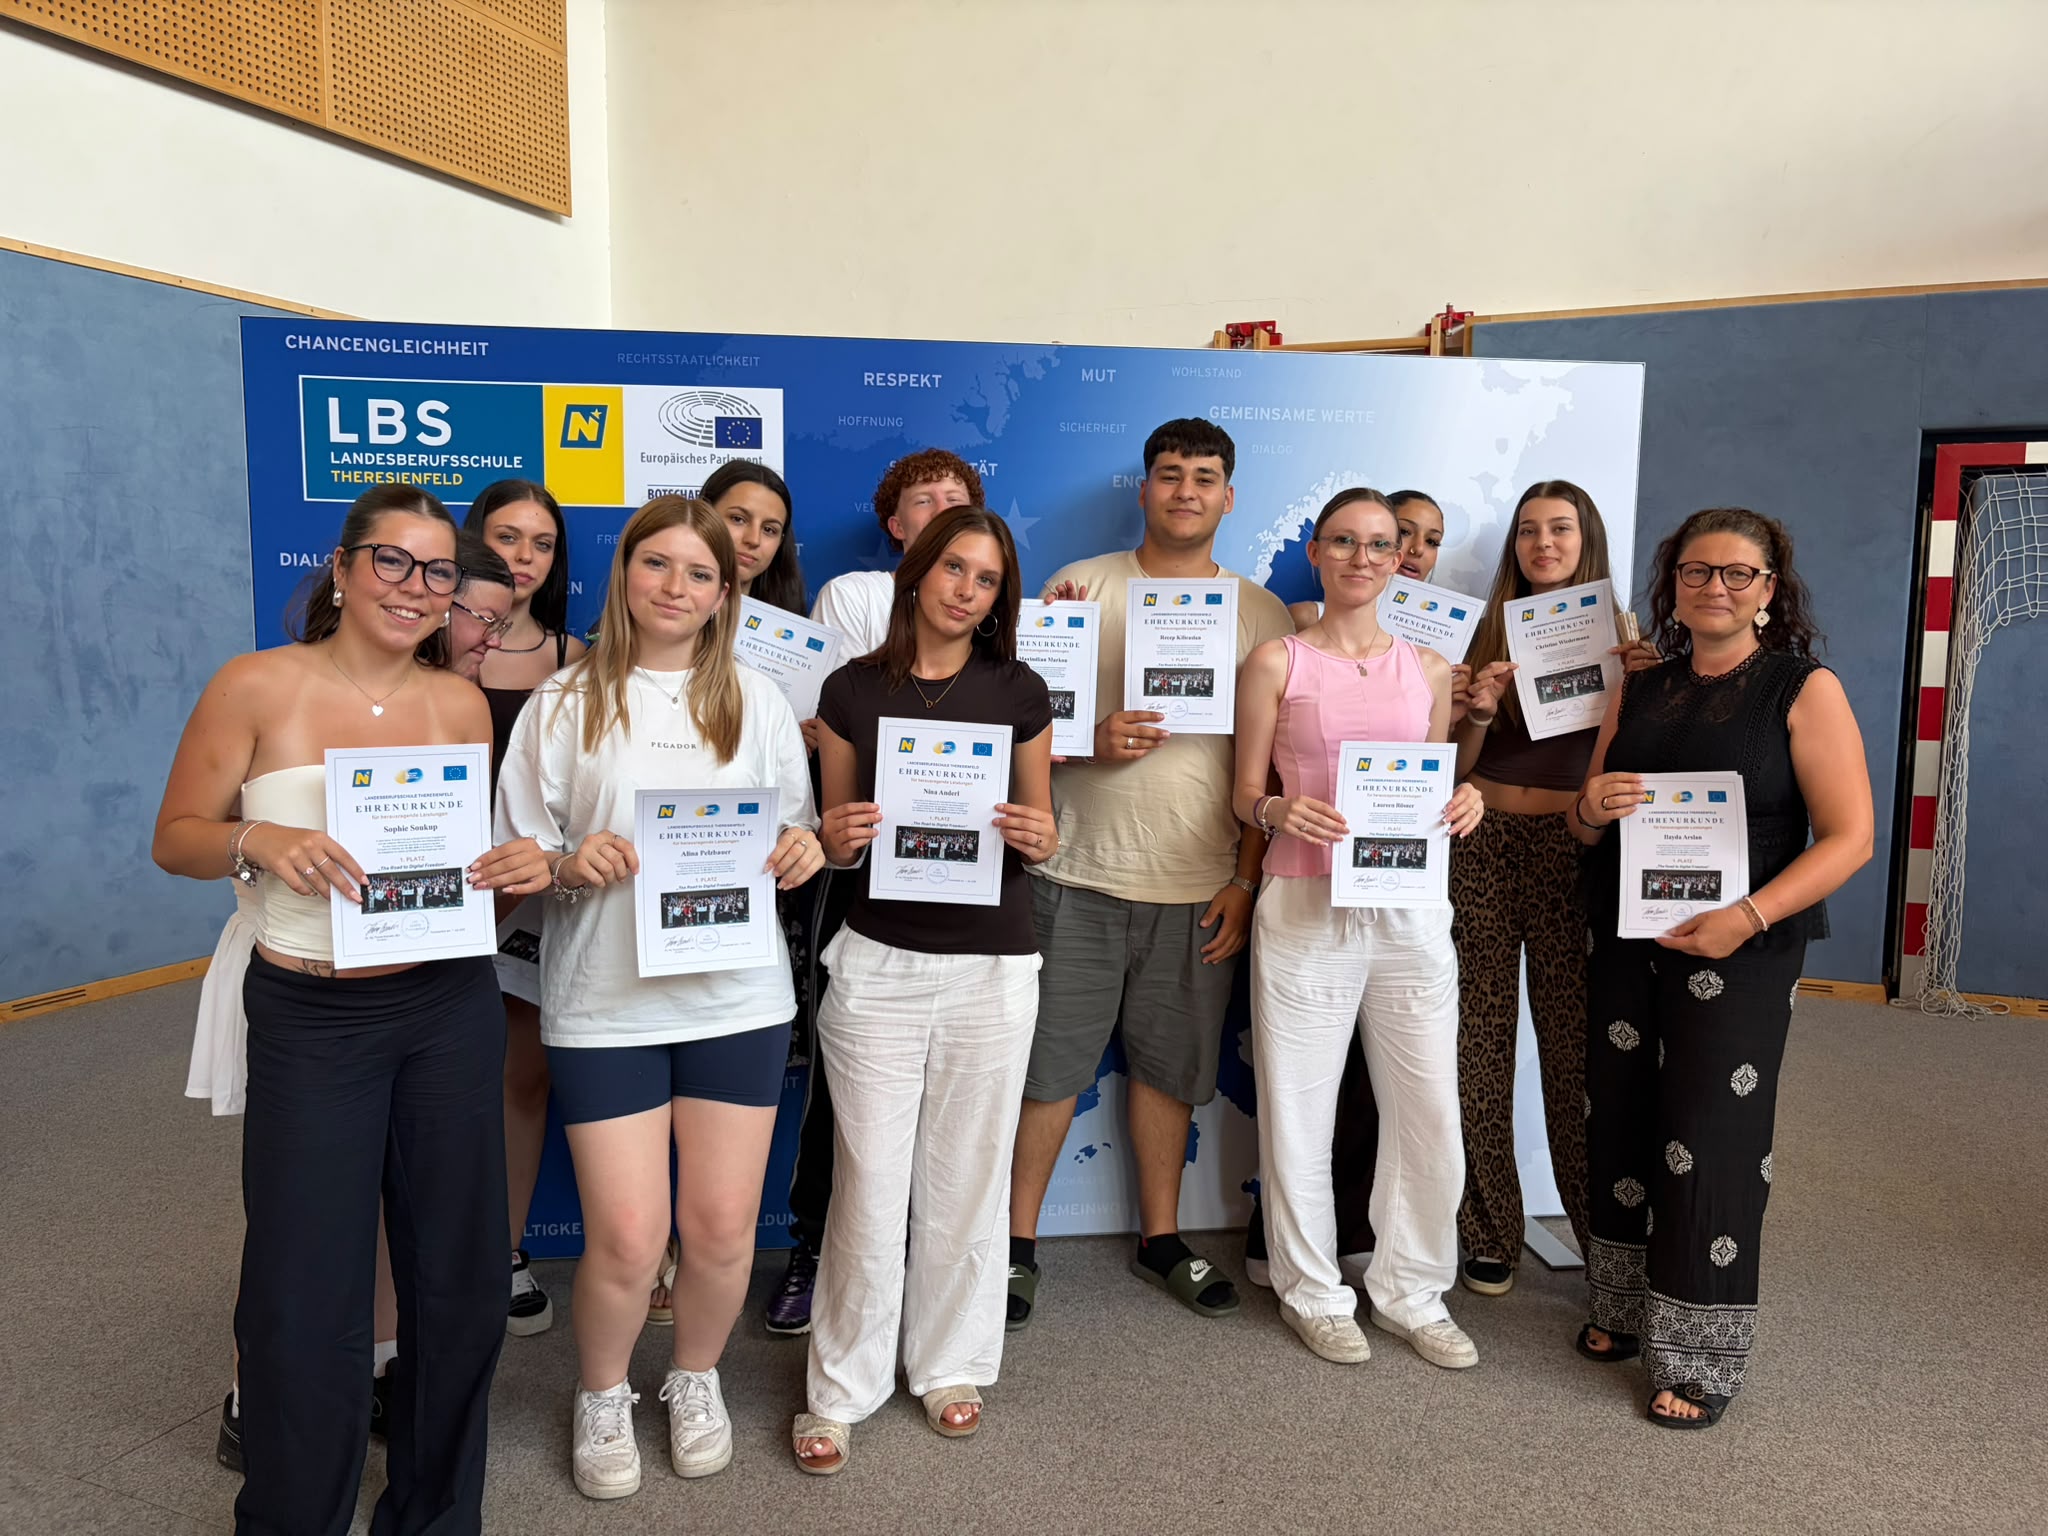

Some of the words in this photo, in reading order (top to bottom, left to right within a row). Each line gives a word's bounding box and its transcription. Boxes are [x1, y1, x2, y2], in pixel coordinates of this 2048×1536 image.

[285, 334, 489, 356] CHANCENGLEICHHEIT
[617, 352, 761, 367] RECHTSSTAATLICHKEIT
[1081, 368, 1117, 383] MUT
[1171, 366, 1242, 379] WOHLSTAND
[863, 371, 942, 389] RESPEKT
[1209, 405, 1316, 423] GEMEINSAME
[1321, 407, 1375, 424] WERTE
[328, 397, 453, 447] LBS
[838, 415, 903, 429] HOFFNUNG
[1059, 421, 1127, 435] SICHERHEIT
[1251, 443, 1293, 455] DIALOG
[329, 451, 523, 469] LANDESBERUFSSCHULE
[640, 452, 707, 466] Europäisches
[330, 470, 463, 486] THERESIENFELD
[1387, 613, 1455, 638] EHRENURKUNDE
[1525, 618, 1596, 638] EHRENURKUNDE
[1016, 640, 1080, 648] RENURKUNDE
[740, 639, 813, 670] EHRENURKUNDE
[651, 741, 697, 749] PEGADOR
[898, 768, 987, 780] EHRENURKUNDE
[1356, 785, 1434, 793] EHRENURKUNDE
[355, 800, 463, 813] EHRENURKUNDE
[383, 825, 409, 834] Sophie
[410, 824, 438, 832] Soukup
[659, 830, 754, 839] EHRENURKUNDE
